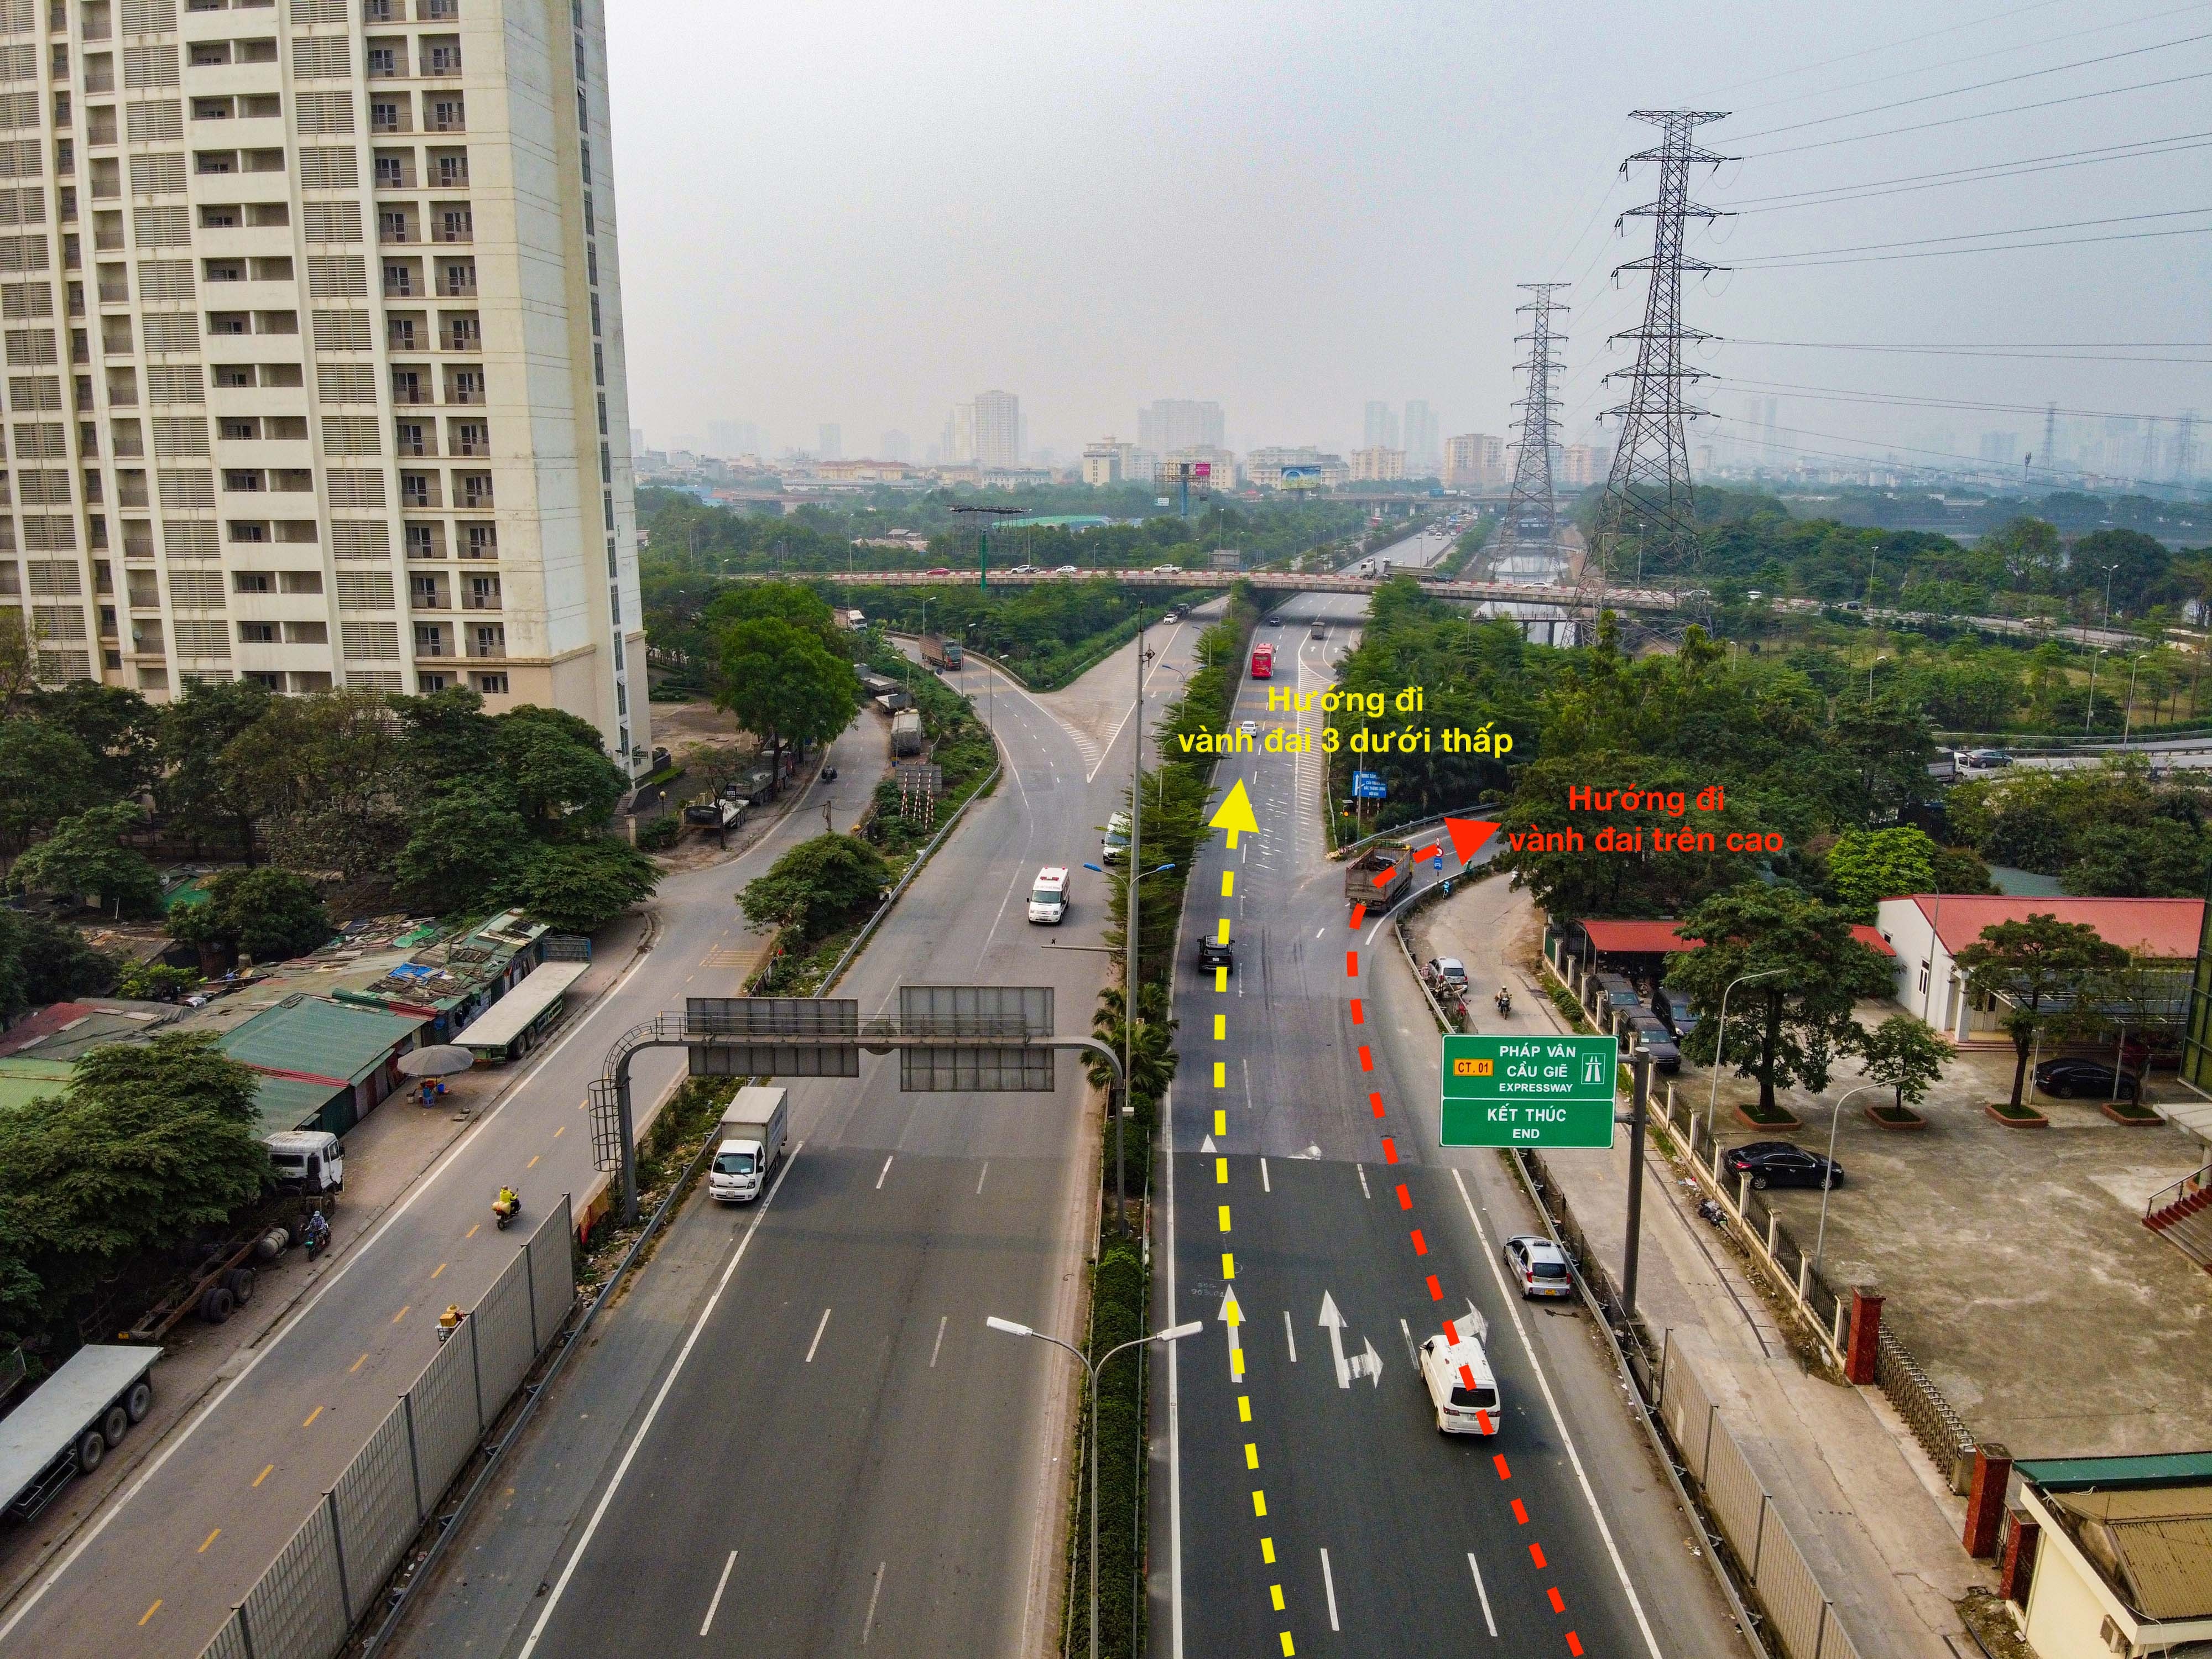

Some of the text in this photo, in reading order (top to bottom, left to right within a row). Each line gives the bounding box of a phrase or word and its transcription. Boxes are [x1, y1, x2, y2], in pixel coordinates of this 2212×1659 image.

[1500, 1042, 1575, 1058] PHÁP VÂN
[1458, 1062, 1488, 1073] CT.01
[1507, 1061, 1567, 1078] CẦU GIẼ
[1499, 1083, 1573, 1092] EXPRESSWAY
[1488, 1103, 1567, 1122] KẾT THÚC
[1512, 1129, 1540, 1139] END
